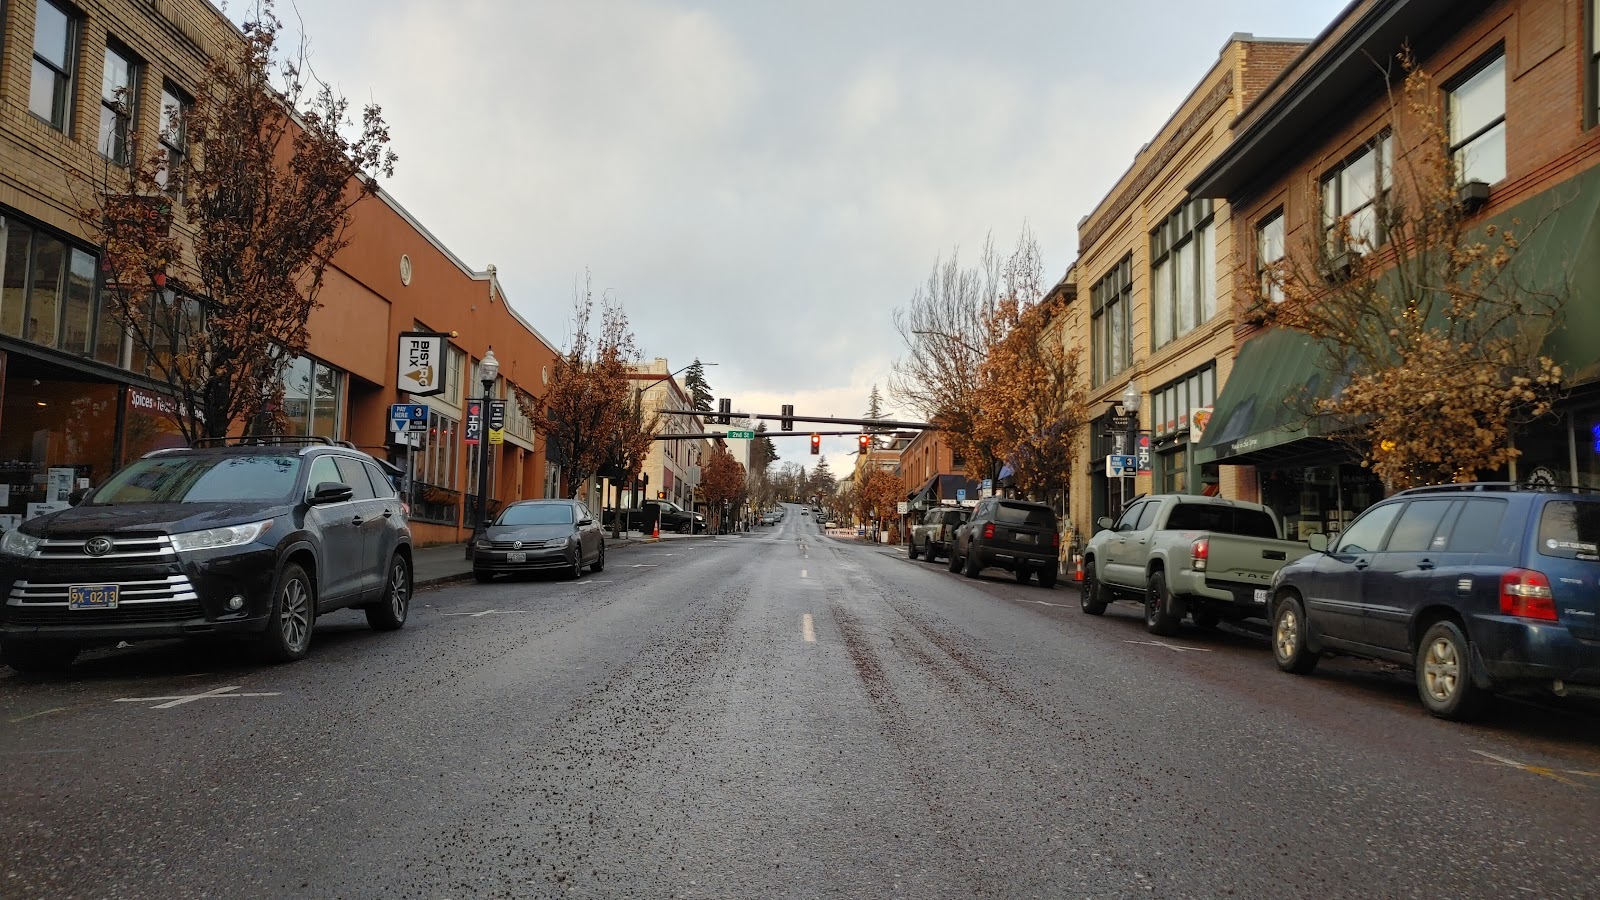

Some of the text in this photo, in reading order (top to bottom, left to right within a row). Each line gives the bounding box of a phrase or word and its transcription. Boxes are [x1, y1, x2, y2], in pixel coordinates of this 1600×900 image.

[409, 340, 419, 367] FLIX
[418, 340, 430, 387] BISTRO
[131, 391, 153, 408] Spices
[414, 407, 423, 417] 3
[71, 591, 116, 604] 9X-0213
